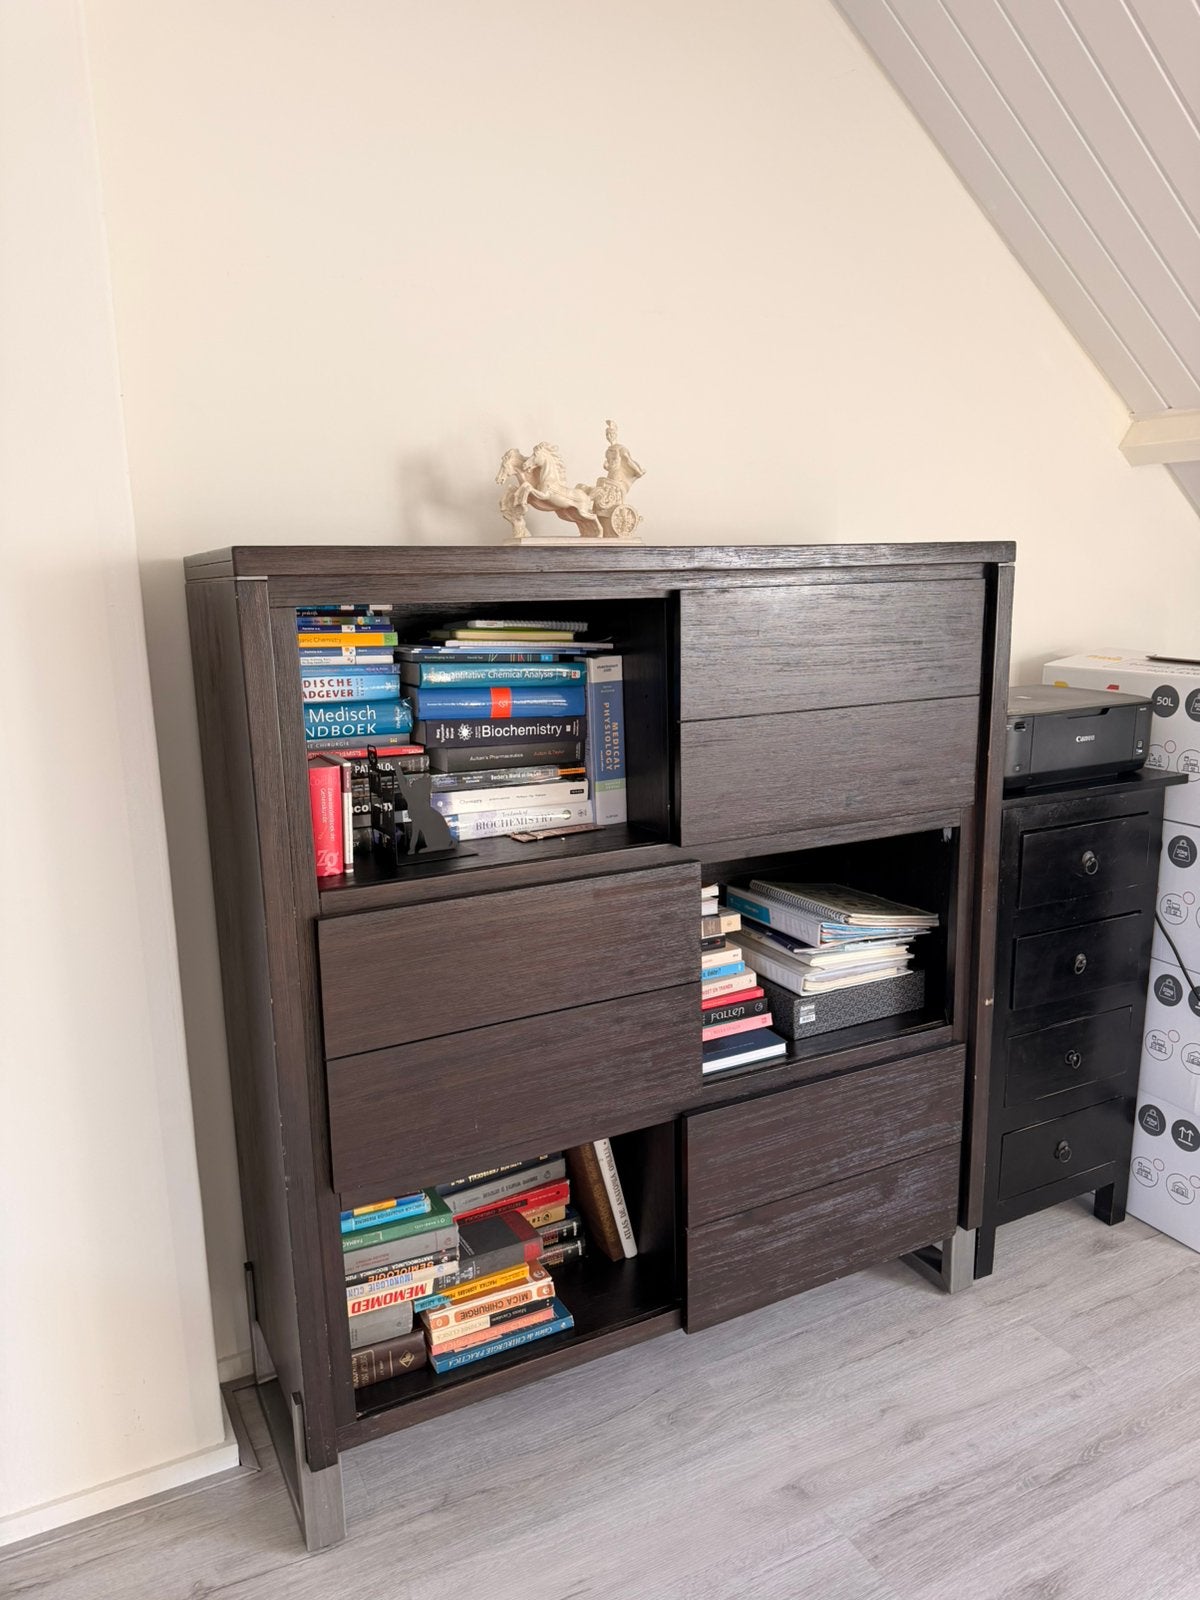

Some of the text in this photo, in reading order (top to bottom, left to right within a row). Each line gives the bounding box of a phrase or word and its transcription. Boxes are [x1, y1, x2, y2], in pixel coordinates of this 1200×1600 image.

[487, 669, 523, 679] Chemical
[524, 668, 554, 680] Analysis
[1156, 696, 1175, 707] 50L
[309, 705, 377, 723] Medisch
[481, 722, 563, 739] Biochemistry
[603, 702, 614, 771] PHYSIOLOGY
[1075, 734, 1096, 743] Canon
[611, 721, 621, 770] MEDICAL
[475, 813, 555, 831] BIOCHEMISTRY
[368, 1260, 435, 1283] SEMIOLOGIE
[351, 1283, 427, 1315] MEMOMED
[460, 1292, 529, 1320] MICA CHIRURGIE
[486, 1332, 530, 1356] CHIRURGIE
[530, 1330, 538, 1339] de
[448, 1347, 486, 1369] PRACTICA
